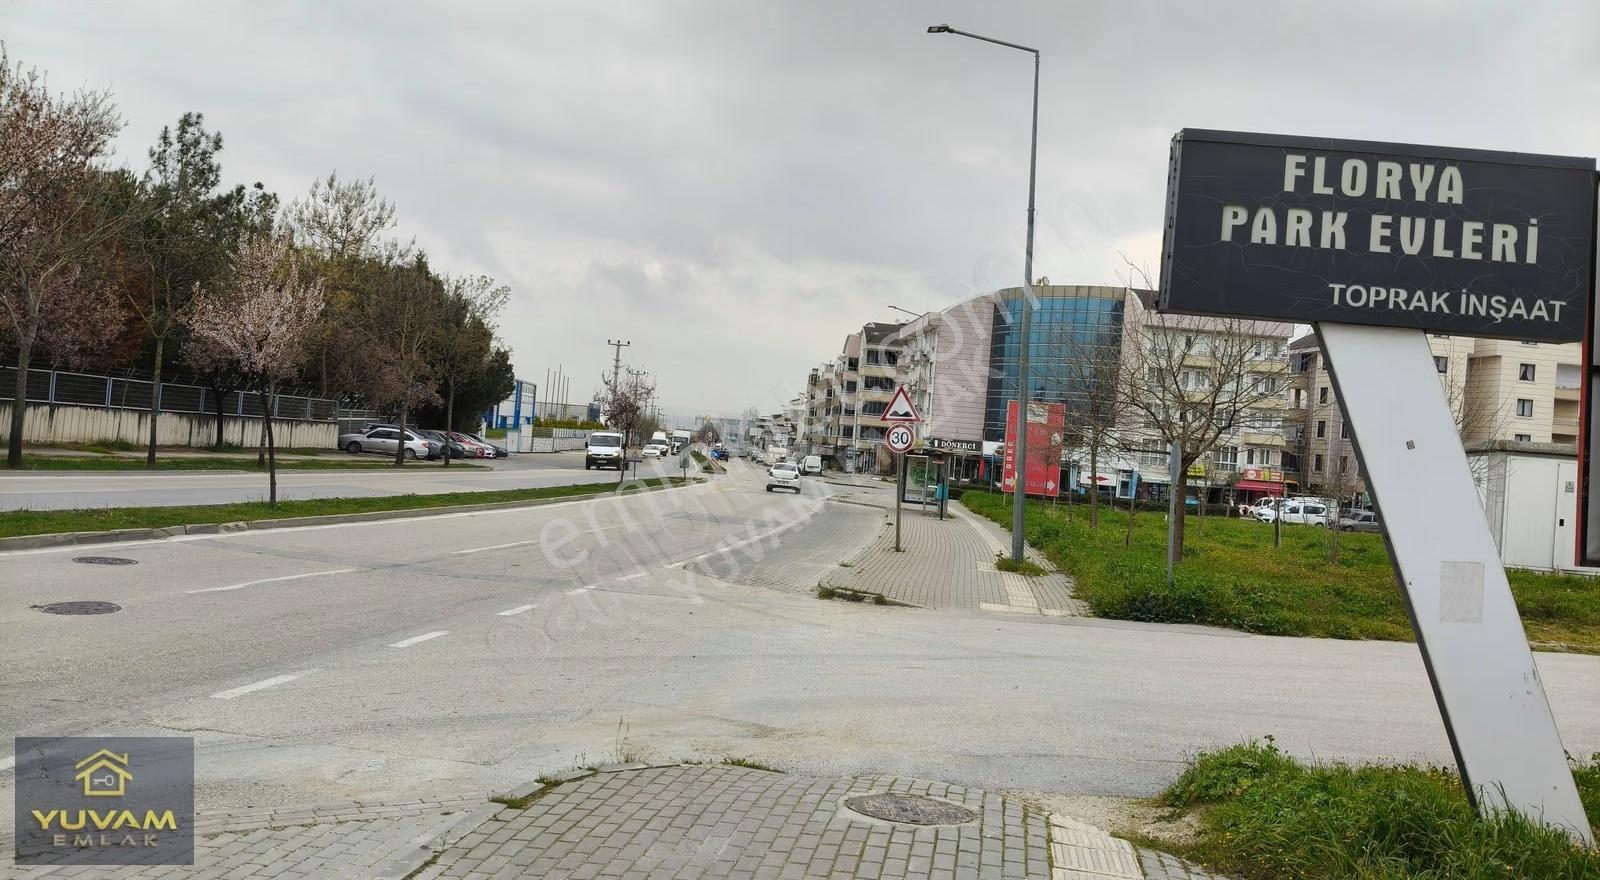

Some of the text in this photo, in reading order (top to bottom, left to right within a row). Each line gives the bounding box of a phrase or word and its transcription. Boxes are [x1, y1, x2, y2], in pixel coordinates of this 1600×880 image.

[1283, 154, 1464, 205] FLORYA
[1220, 205, 1539, 264] PARK EVLERİ
[1328, 283, 1567, 323] TOPRAK İNŞAAT
[891, 431, 909, 445] 30
